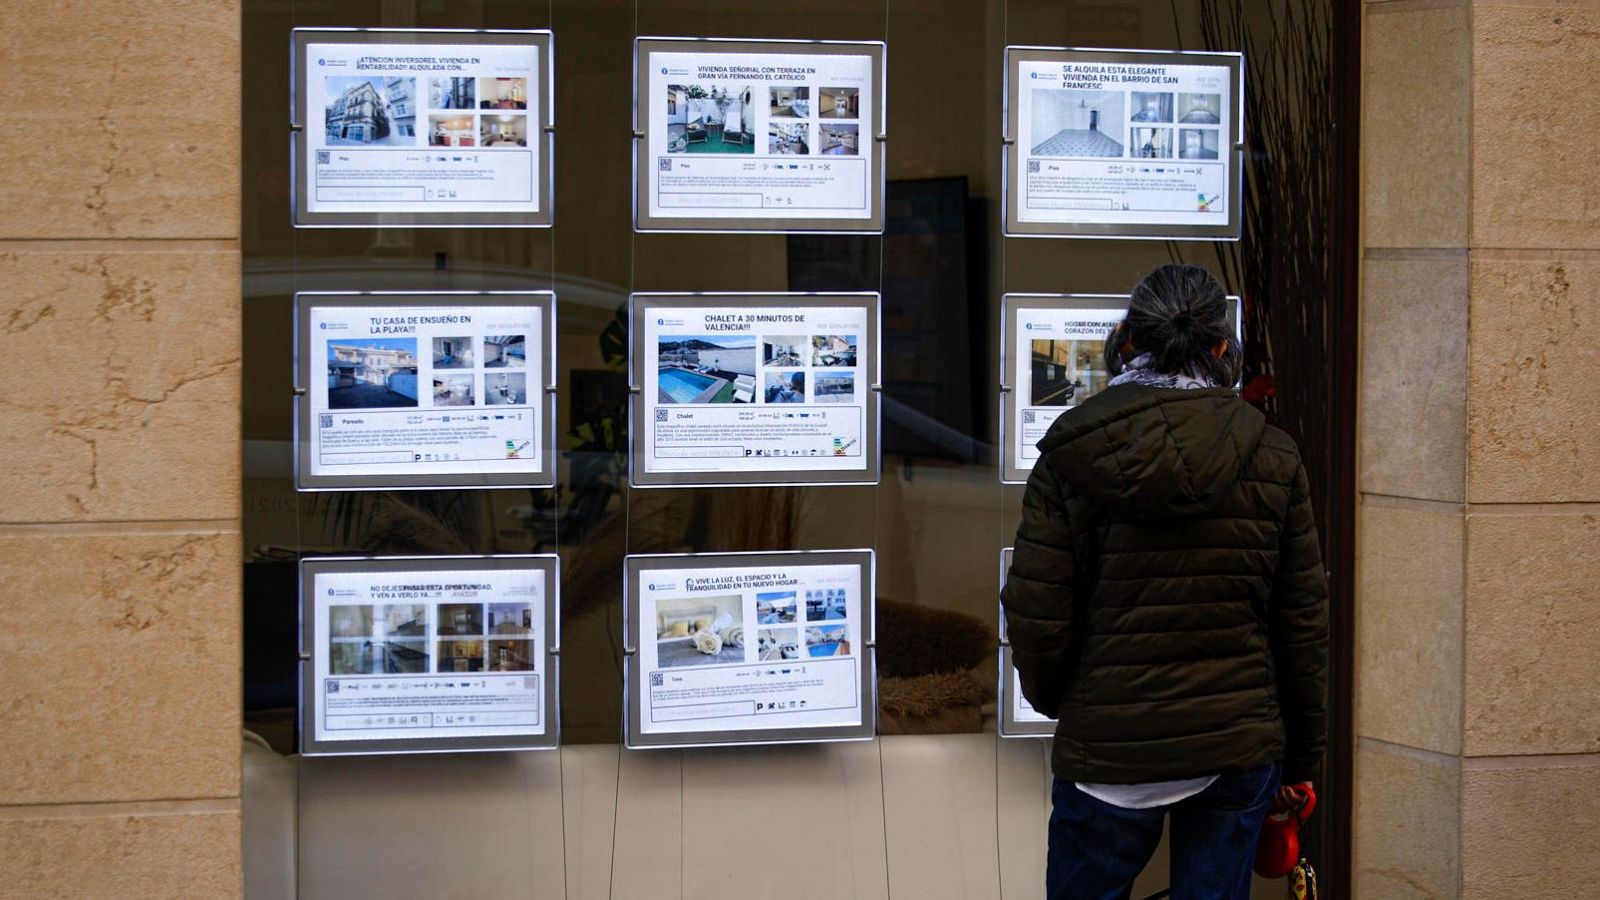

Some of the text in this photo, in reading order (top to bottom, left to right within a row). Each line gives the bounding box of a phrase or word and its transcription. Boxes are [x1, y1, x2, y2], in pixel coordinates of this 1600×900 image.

[1074, 66, 1106, 74] ALQUILA
[1128, 67, 1166, 75] ELEGANTE
[1063, 74, 1098, 82] VIVIENDA
[370, 314, 471, 325] TU CASA DE ENSUEÑO EN
[370, 326, 416, 334] LA PLAYA!!!
[705, 323, 751, 331] VALENCIA!!!
[415, 454, 422, 462] P
[744, 574, 772, 582] ESPACIO
[686, 583, 733, 591] TRANQUILIDAD
